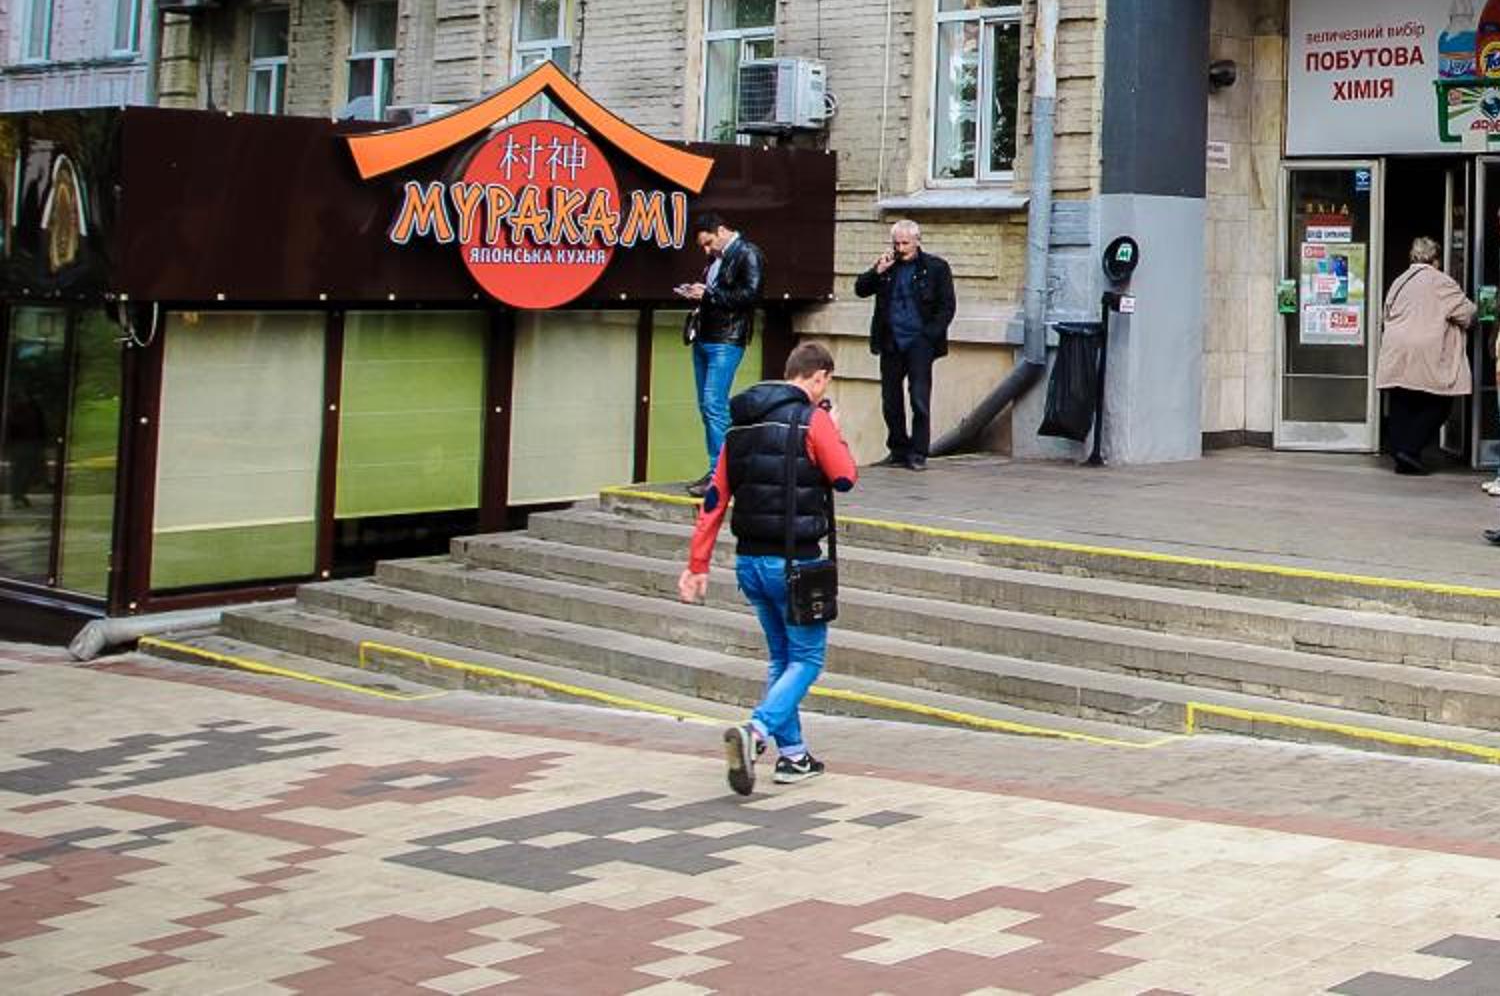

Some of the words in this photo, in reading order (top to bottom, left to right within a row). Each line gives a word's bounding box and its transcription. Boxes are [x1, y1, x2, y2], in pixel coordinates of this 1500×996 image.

[1306, 45, 1424, 71] ПОБУТОВА
[1333, 78, 1393, 100] ХІМІЯ
[500, 134, 587, 181] 村神
[390, 181, 688, 249] МУРАКАМІ
[469, 247, 552, 265] ЯПОНСЬКА
[556, 248, 606, 265] КУХНЯ
